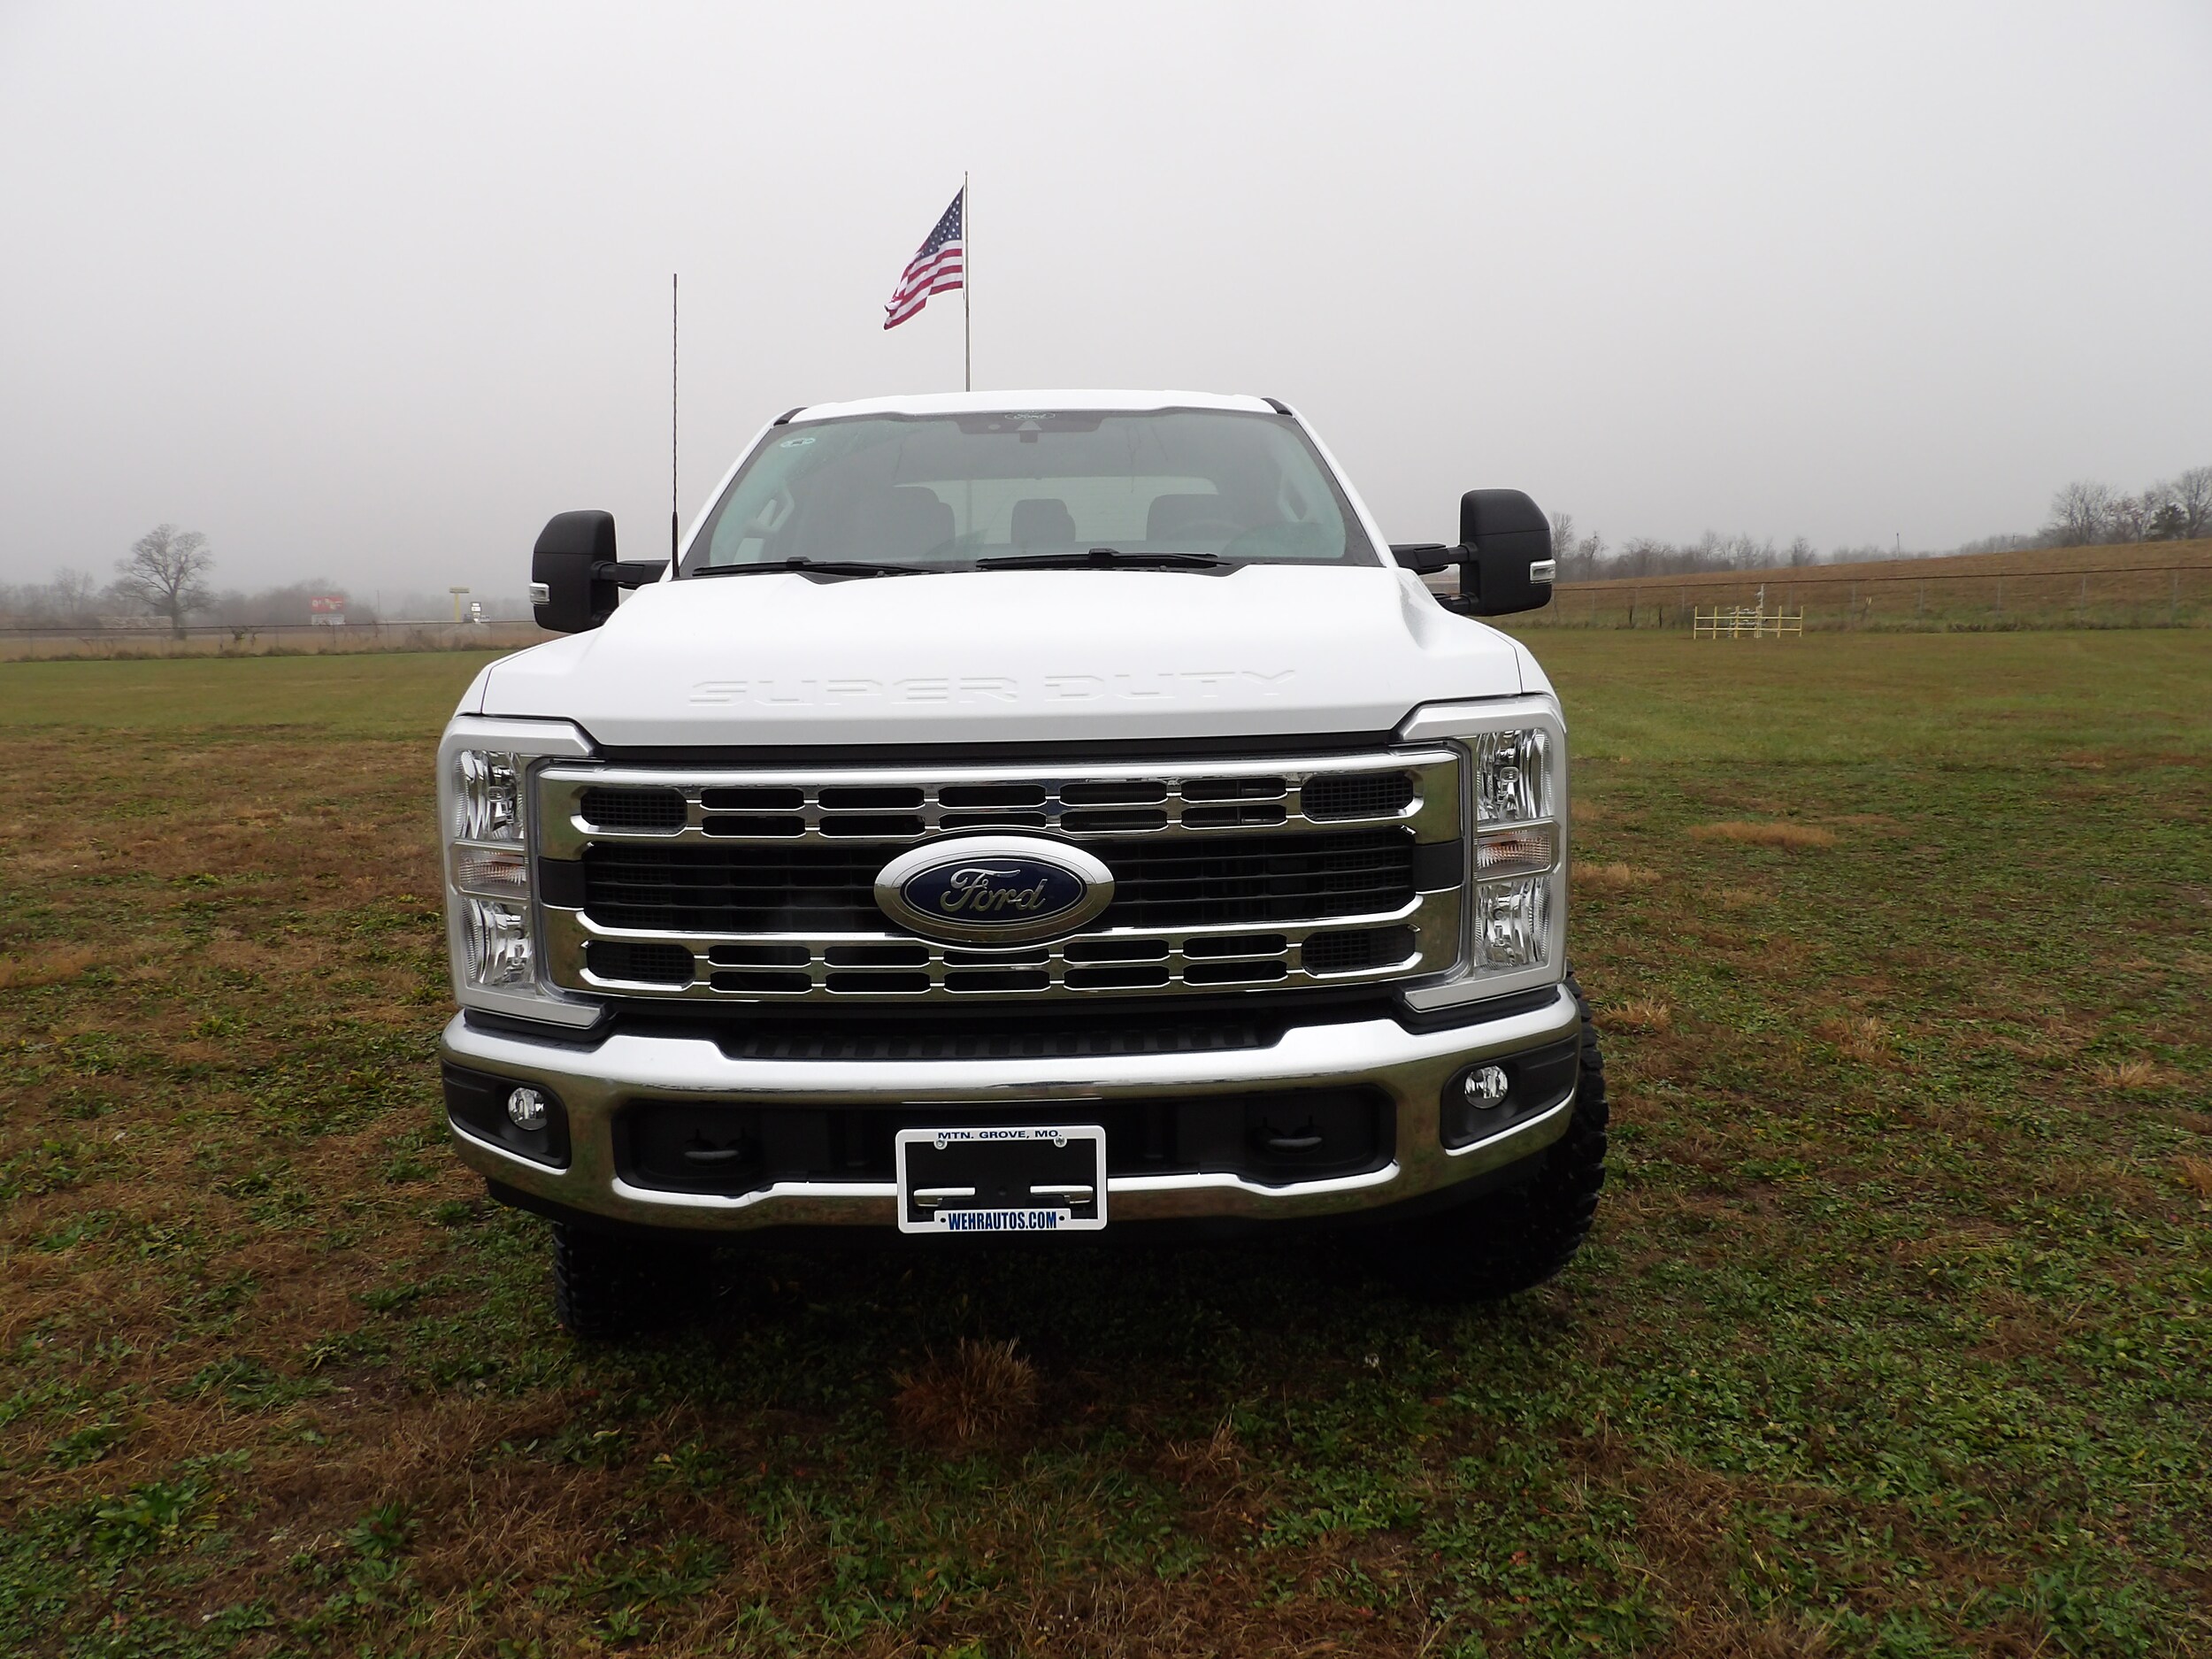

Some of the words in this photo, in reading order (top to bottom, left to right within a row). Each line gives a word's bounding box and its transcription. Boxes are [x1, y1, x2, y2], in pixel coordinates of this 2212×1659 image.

[688, 677, 1018, 706] SUPER
[1044, 670, 1295, 702] DUTY
[940, 868, 1048, 913] Ford
[979, 1130, 1030, 1140] GROVE,
[949, 1211, 1056, 1230] WEHRAUTOS.COM
